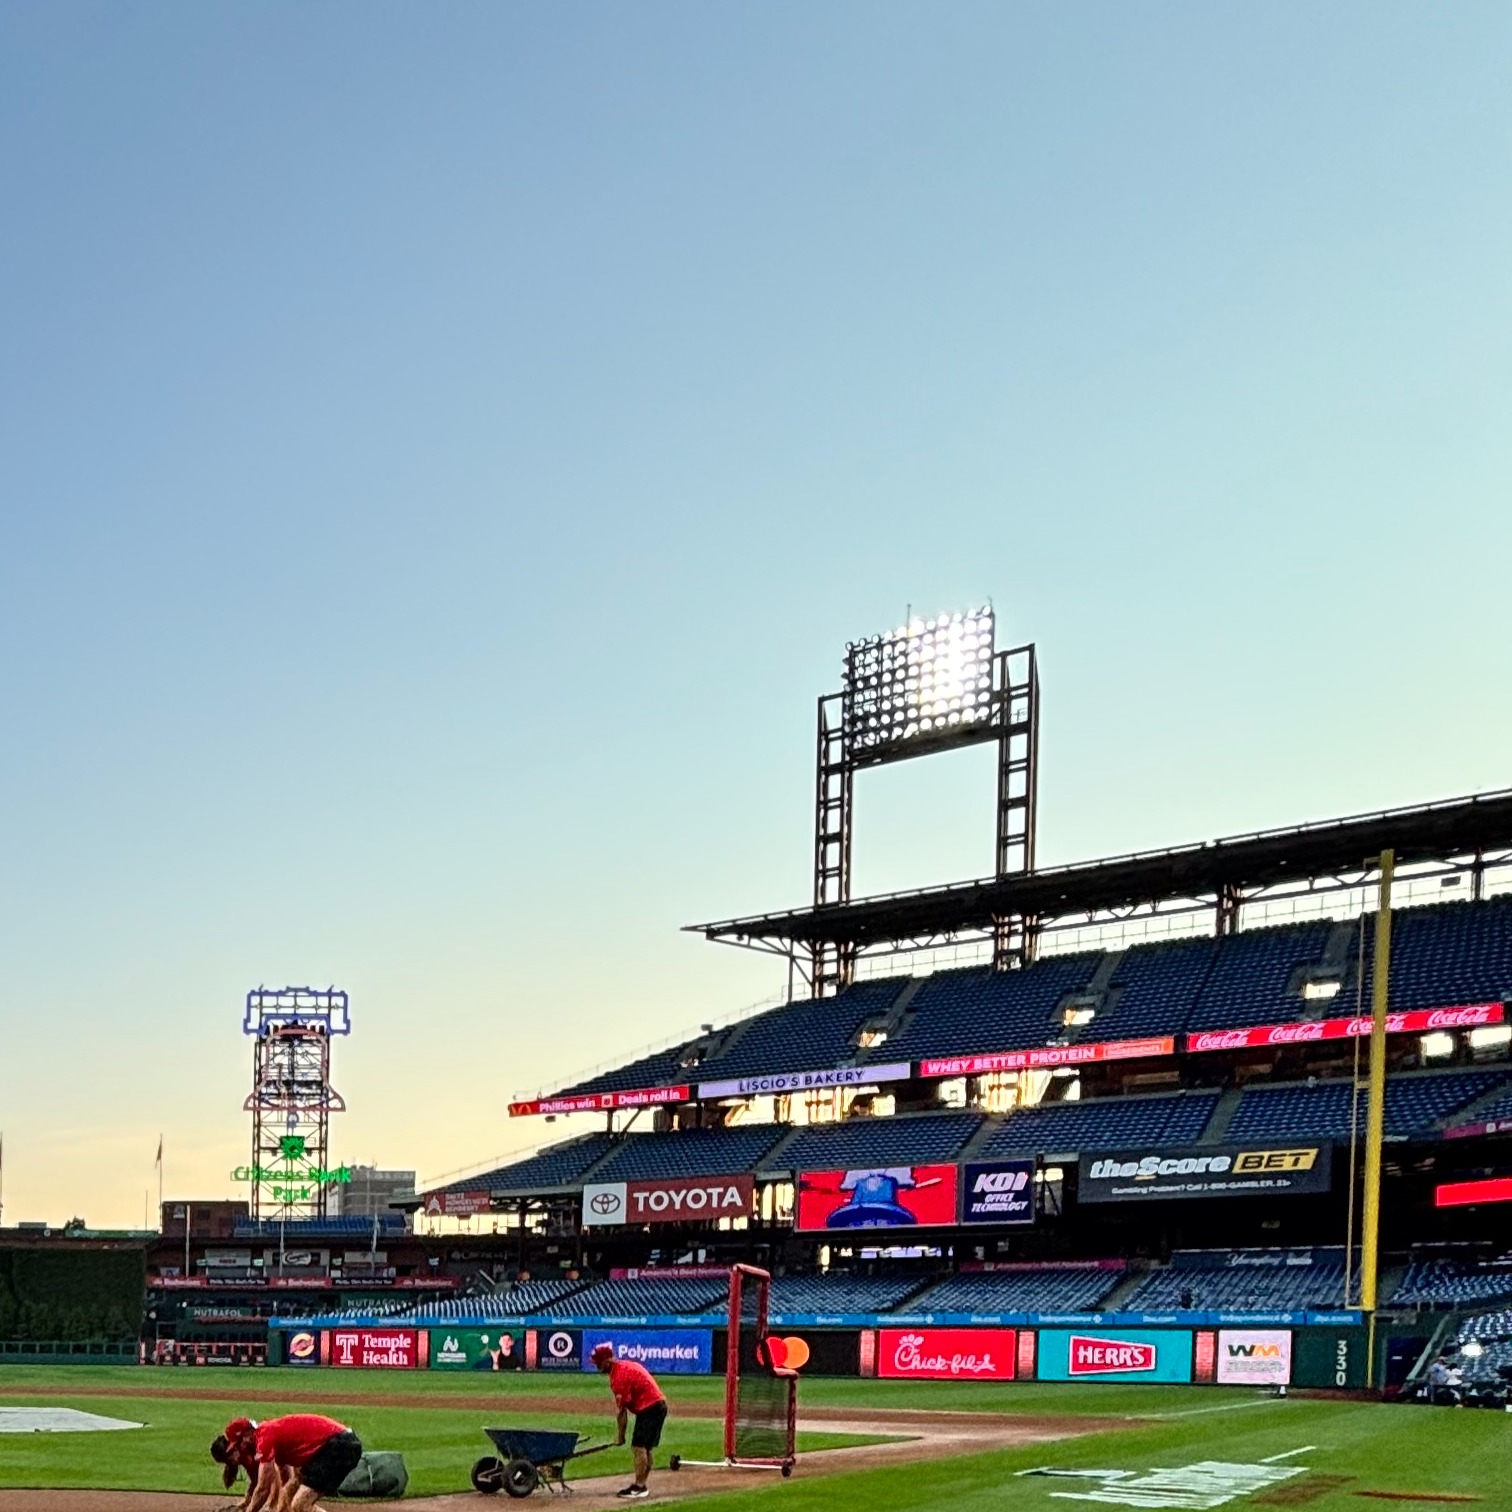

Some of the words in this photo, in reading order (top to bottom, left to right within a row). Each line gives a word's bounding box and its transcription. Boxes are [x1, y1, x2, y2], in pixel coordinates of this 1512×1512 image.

[928, 1060, 971, 1074] WHEY
[973, 1054, 1027, 1070] BETTER
[1030, 1048, 1096, 1065] PROTEIN
[739, 1076, 799, 1092] LISCIO'S
[804, 1070, 864, 1086] BAKERY
[576, 1098, 596, 1109] win
[233, 1166, 305, 1182] Citizens
[308, 1161, 352, 1183] Bank
[1089, 1156, 1232, 1179] theScore
[1238, 1151, 1311, 1170] BET
[972, 1171, 1029, 1193] KDI
[273, 1186, 311, 1200] Park
[633, 1186, 743, 1213] TOYOTA
[985, 1192, 1015, 1204] OFFICE
[971, 1200, 1029, 1213] TECHNOLOGY
[193, 1309, 243, 1317] NUTRAFOL
[362, 1333, 412, 1349] Temple
[1227, 1344, 1281, 1357] WM
[362, 1350, 408, 1365] Health
[617, 1345, 699, 1362] Polymarket
[894, 1335, 996, 1374] Chick-fil-A
[1077, 1345, 1145, 1367] HERR'S
[1335, 1339, 1348, 1387] 330
